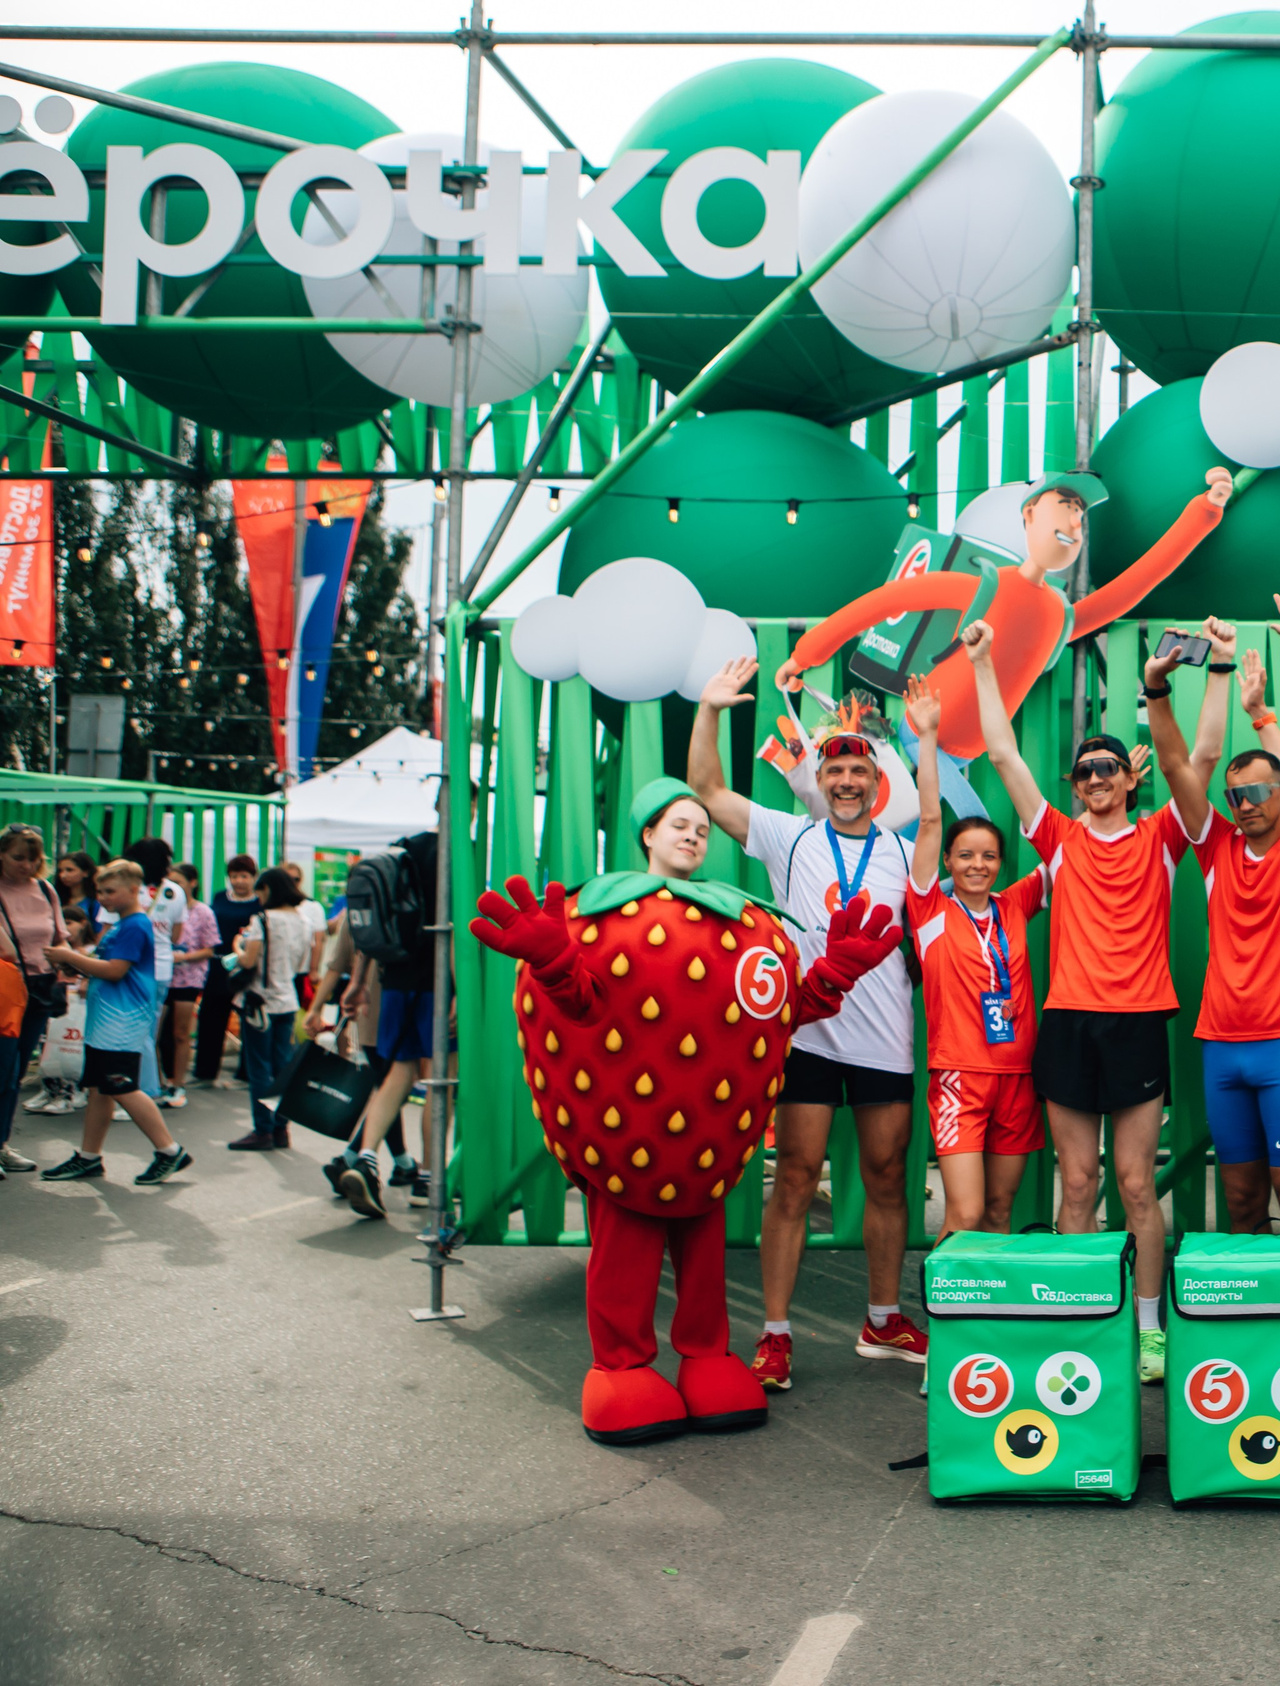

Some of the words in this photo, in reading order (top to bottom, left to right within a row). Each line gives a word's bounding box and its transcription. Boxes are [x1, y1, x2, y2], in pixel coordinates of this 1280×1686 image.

[749, 953, 780, 1006] 5
[988, 1006, 1003, 1031] 3
[931, 1276, 1007, 1289] Доставляем
[1182, 1278, 1259, 1291] Доставляем
[931, 1290, 991, 1302] продукты
[1183, 1291, 1243, 1303] продукты
[1079, 1474, 1110, 1484] 25649
